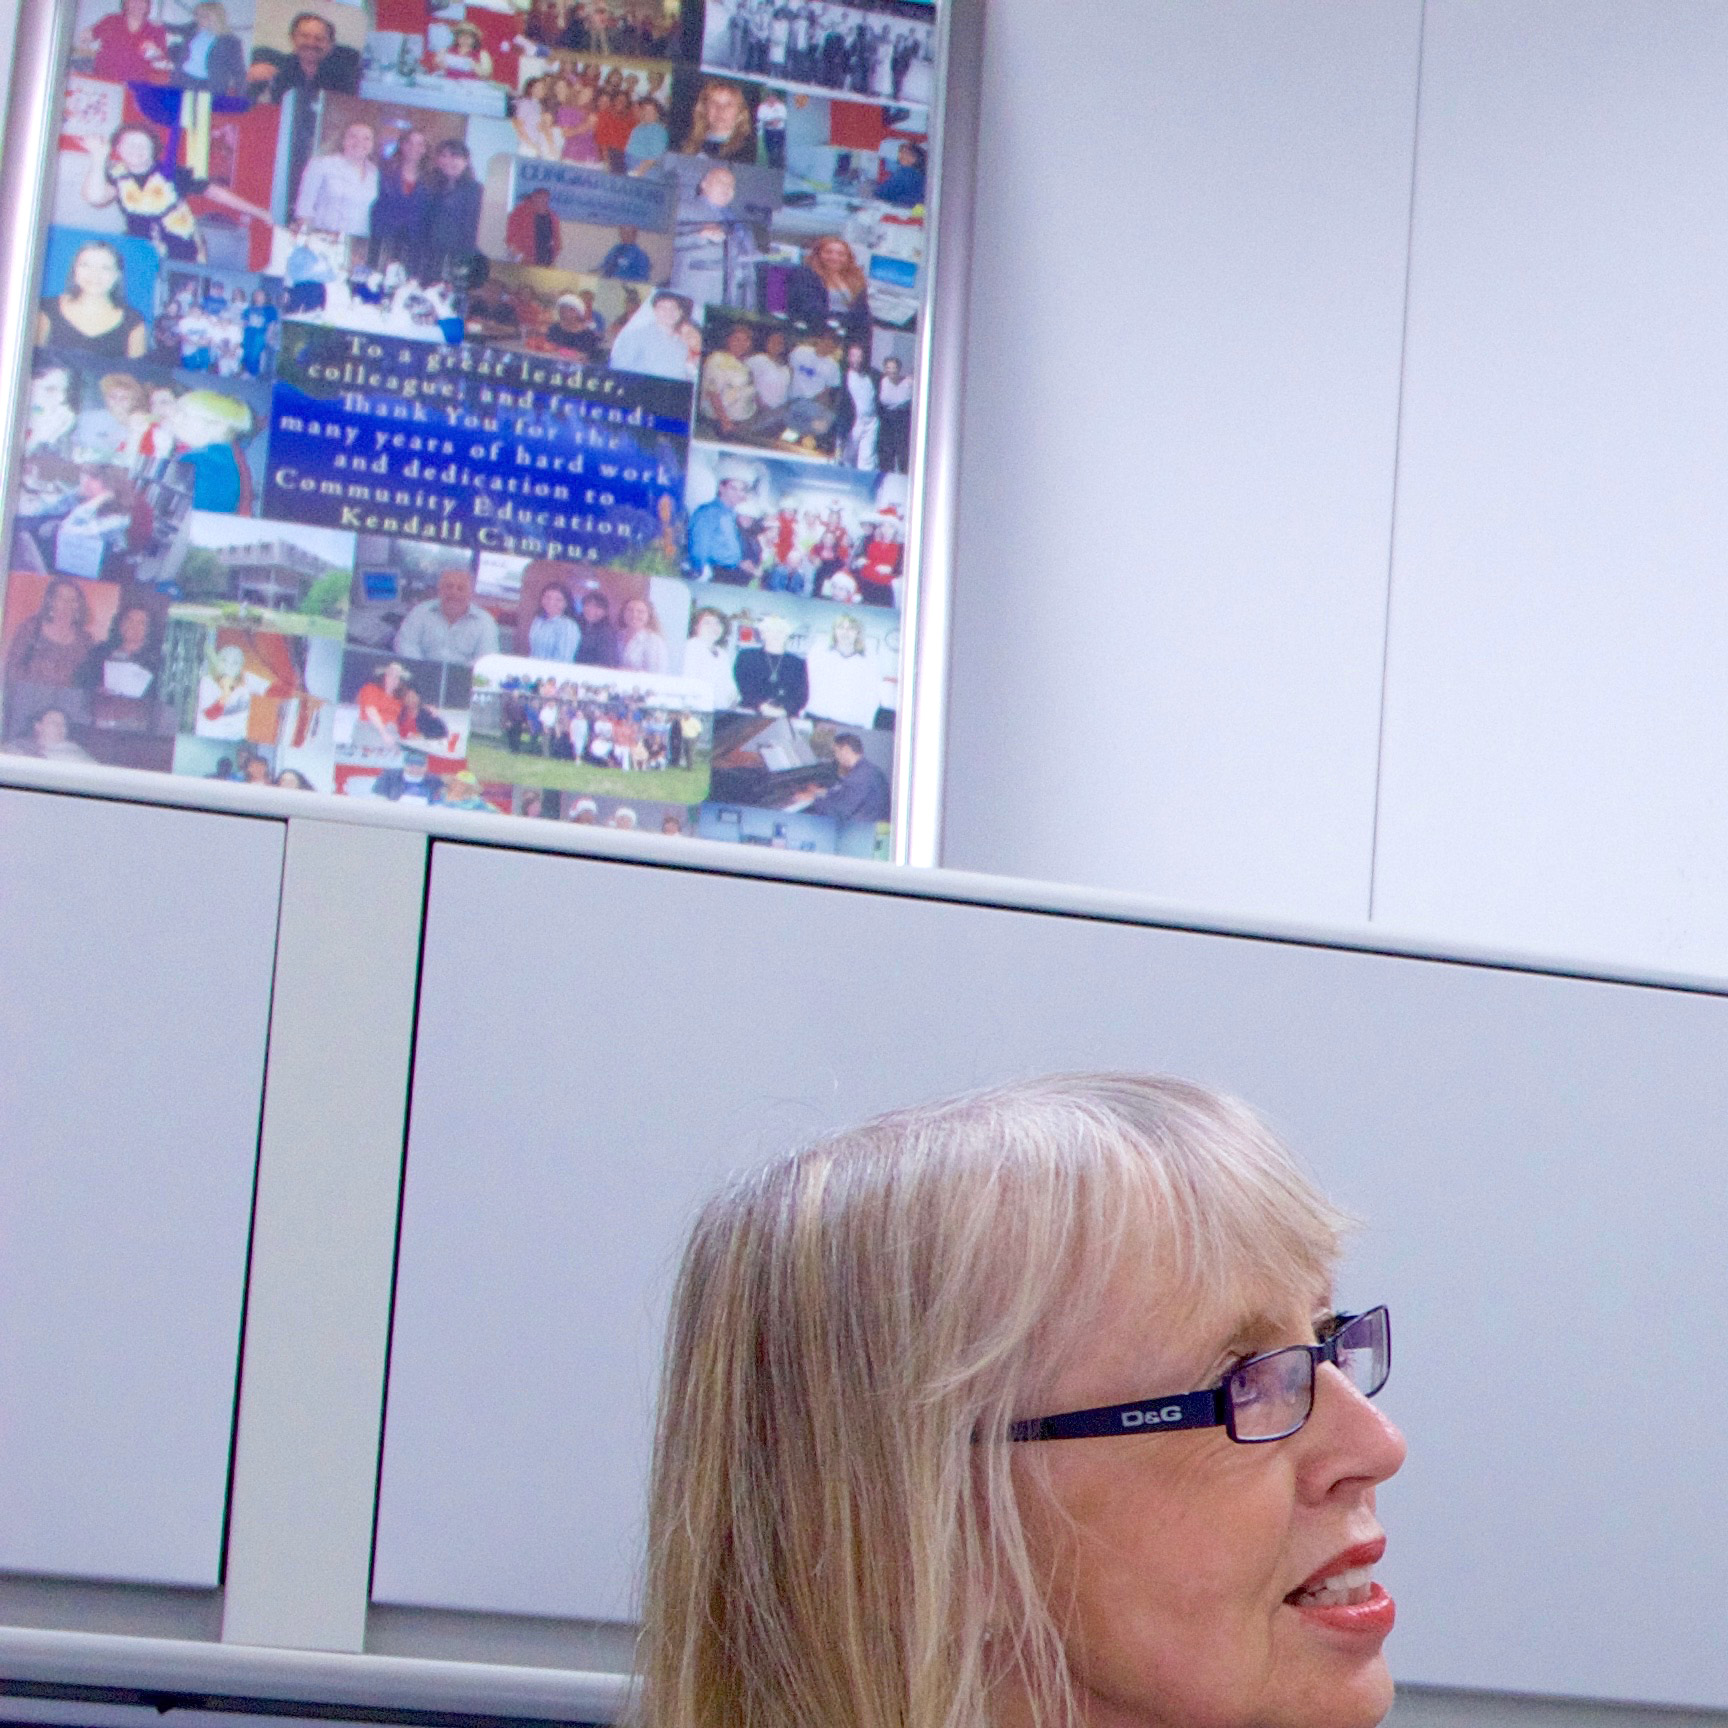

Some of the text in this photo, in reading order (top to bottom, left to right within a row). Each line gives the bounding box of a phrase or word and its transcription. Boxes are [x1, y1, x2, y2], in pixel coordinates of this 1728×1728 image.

[347, 335, 624, 397] To a great leader,
[341, 389, 620, 449] Thank You for the
[480, 387, 535, 409] and
[280, 416, 670, 486] many years of hard work
[275, 467, 456, 516] Community
[334, 453, 615, 505] and dedication to
[341, 505, 598, 560] Kendall Campus
[1121, 1405, 1183, 1428] D&G
